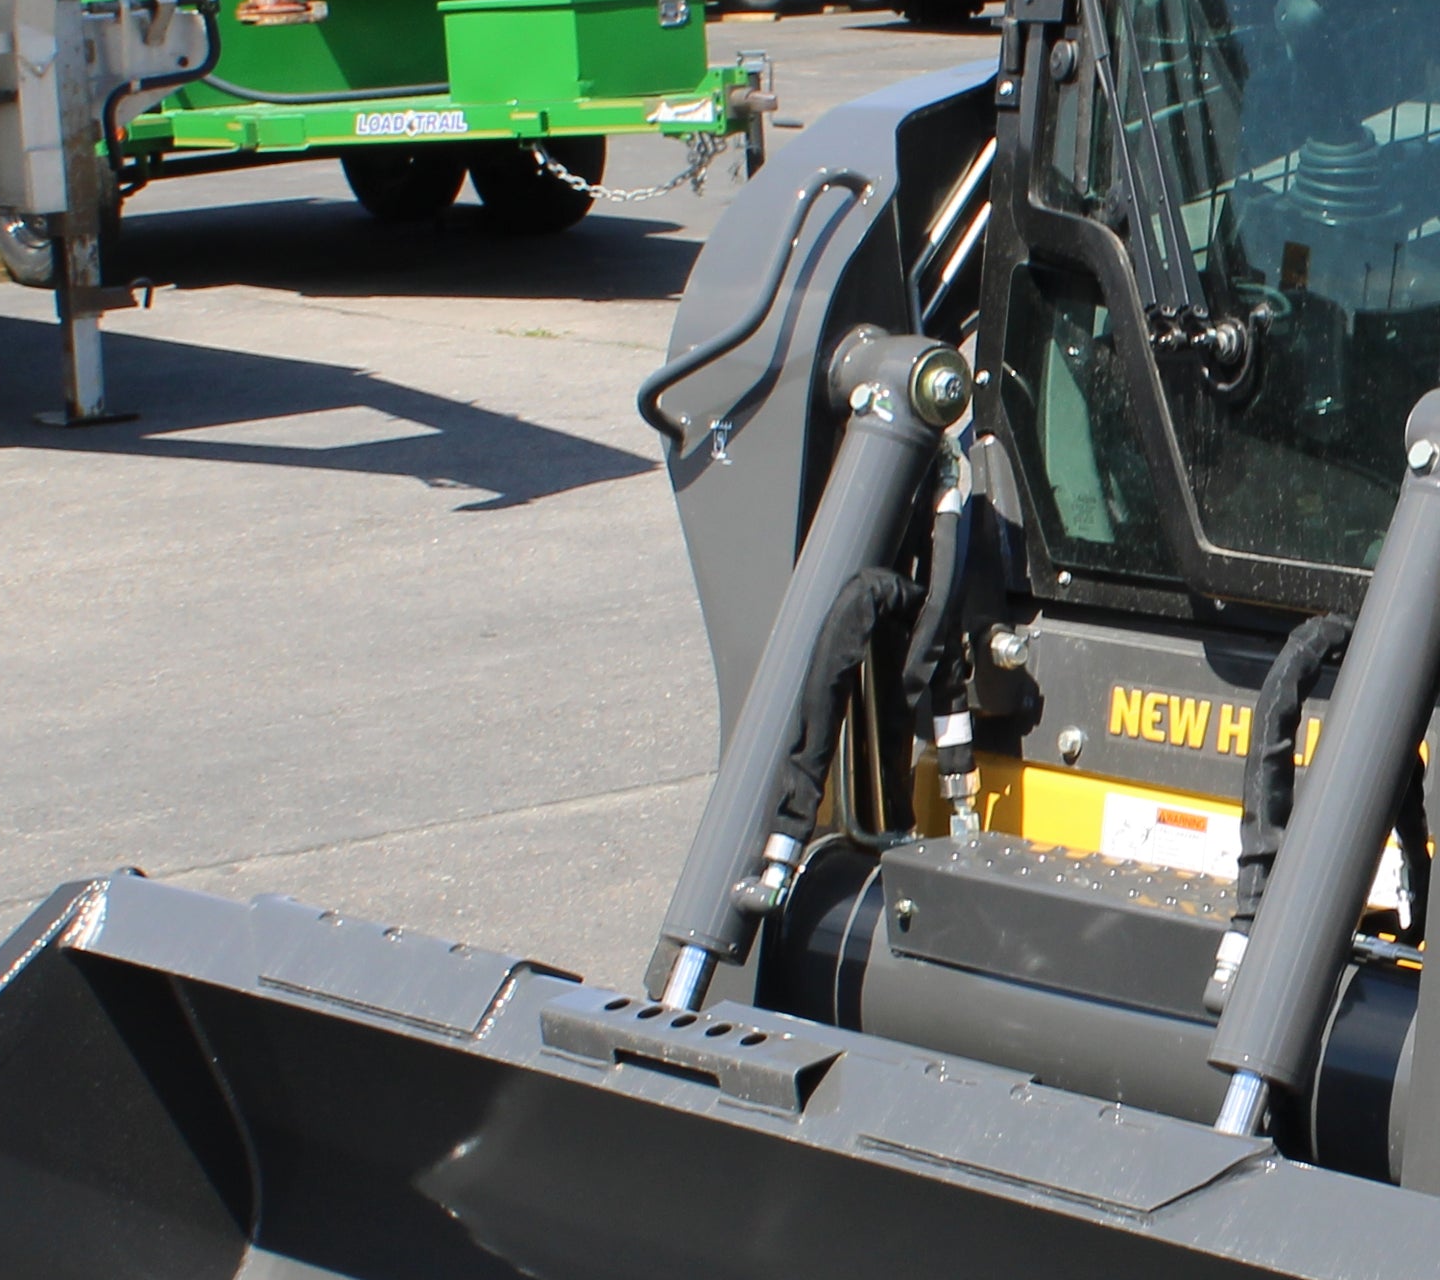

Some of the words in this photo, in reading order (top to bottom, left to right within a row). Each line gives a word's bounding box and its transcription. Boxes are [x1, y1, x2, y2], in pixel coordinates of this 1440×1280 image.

[356, 113, 406, 135] LOAD
[413, 111, 468, 133] TRAIL
[1110, 686, 1211, 749] NEW
